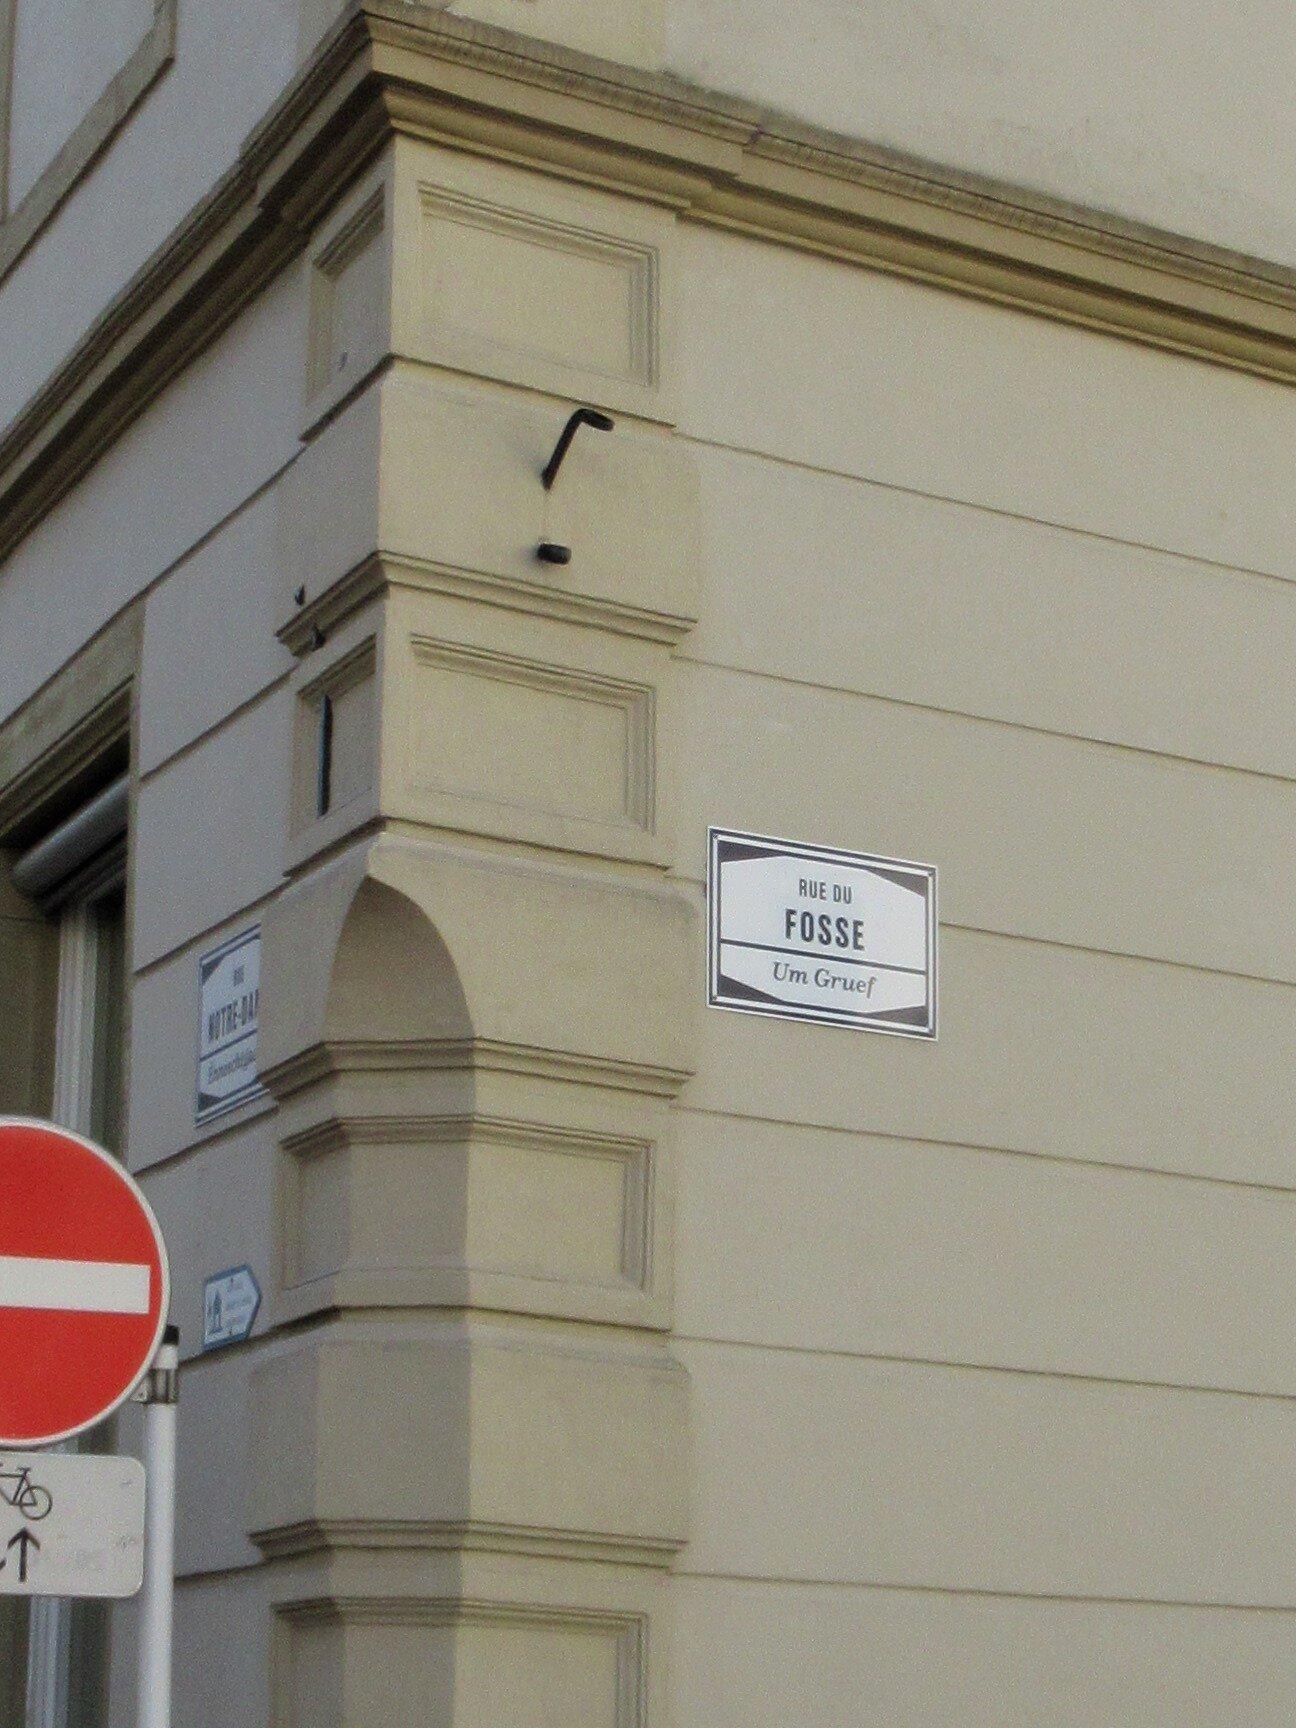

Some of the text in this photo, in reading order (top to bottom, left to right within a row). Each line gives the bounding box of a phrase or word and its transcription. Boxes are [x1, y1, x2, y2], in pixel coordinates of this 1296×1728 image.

[798, 878, 853, 905] RUE DU
[784, 908, 866, 951] FOSSE
[772, 960, 878, 999] Um Gruef
